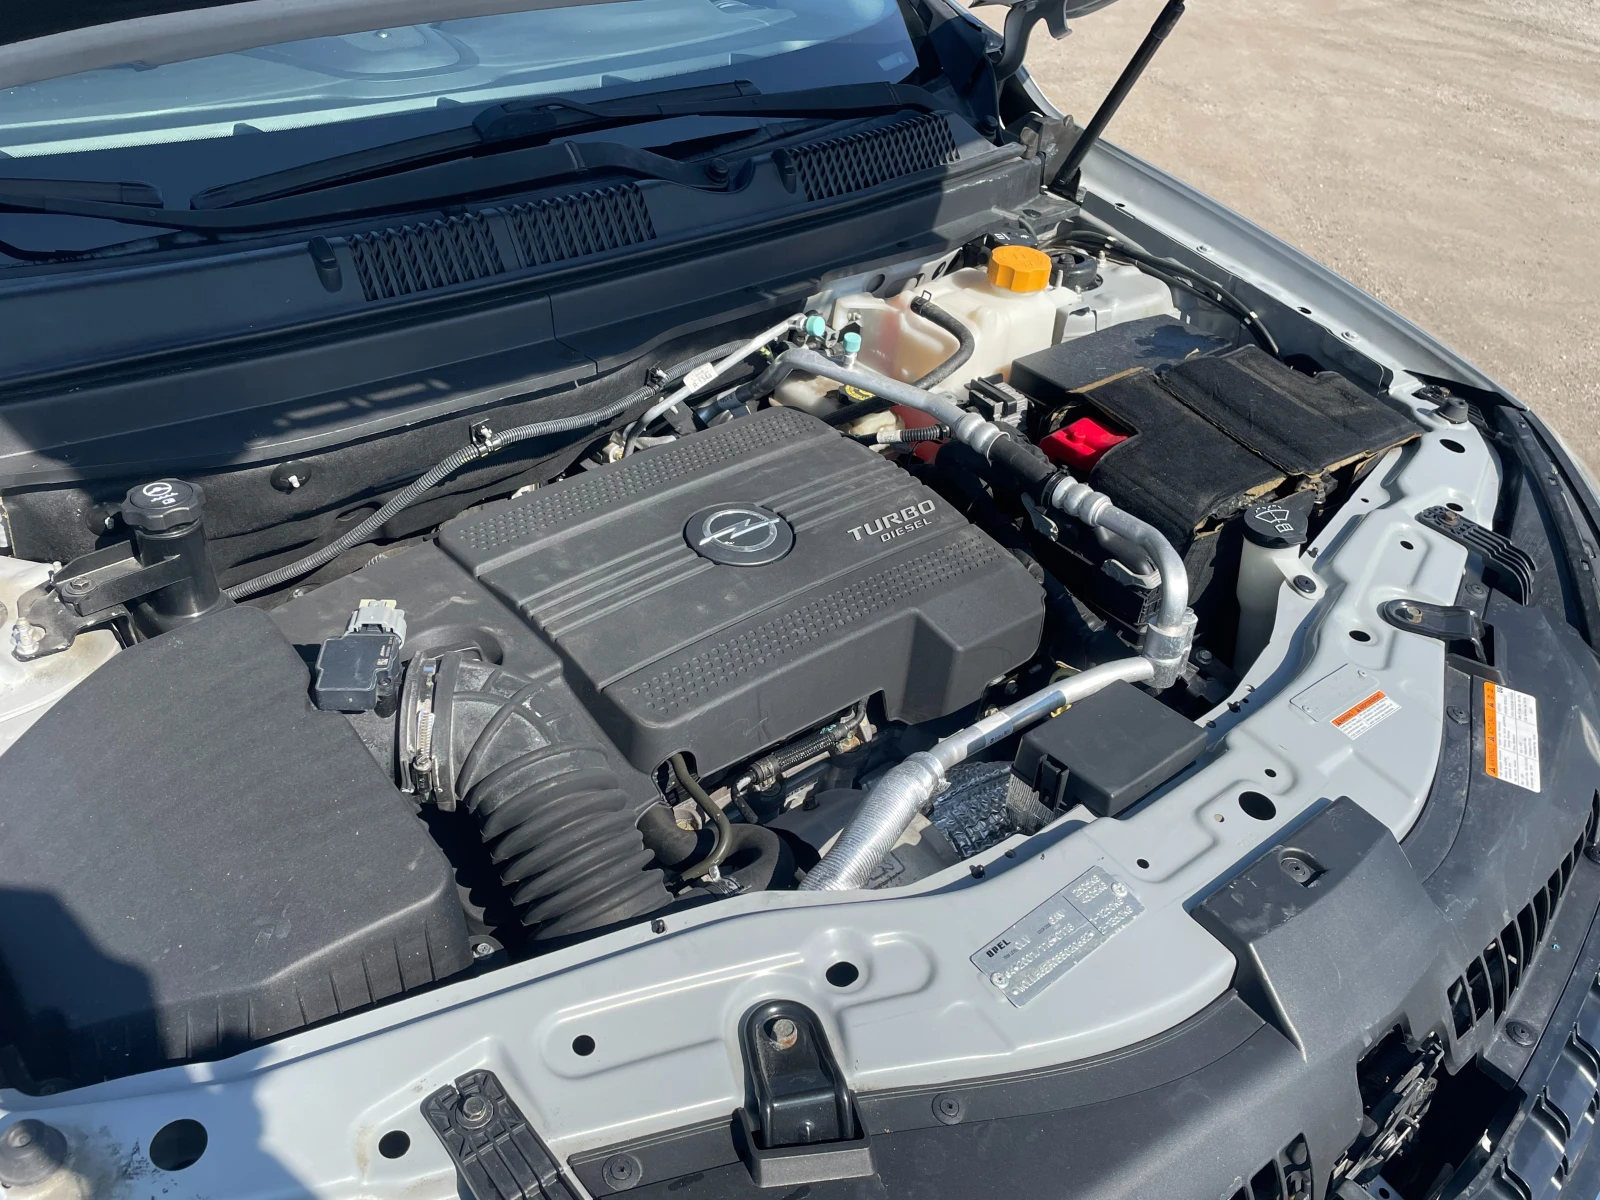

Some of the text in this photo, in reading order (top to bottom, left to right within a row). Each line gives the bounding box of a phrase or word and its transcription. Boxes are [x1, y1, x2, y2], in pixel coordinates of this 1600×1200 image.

[847, 499, 936, 541] TURBO
[880, 518, 933, 542] DIESEL
[985, 939, 1011, 958] OPEL
